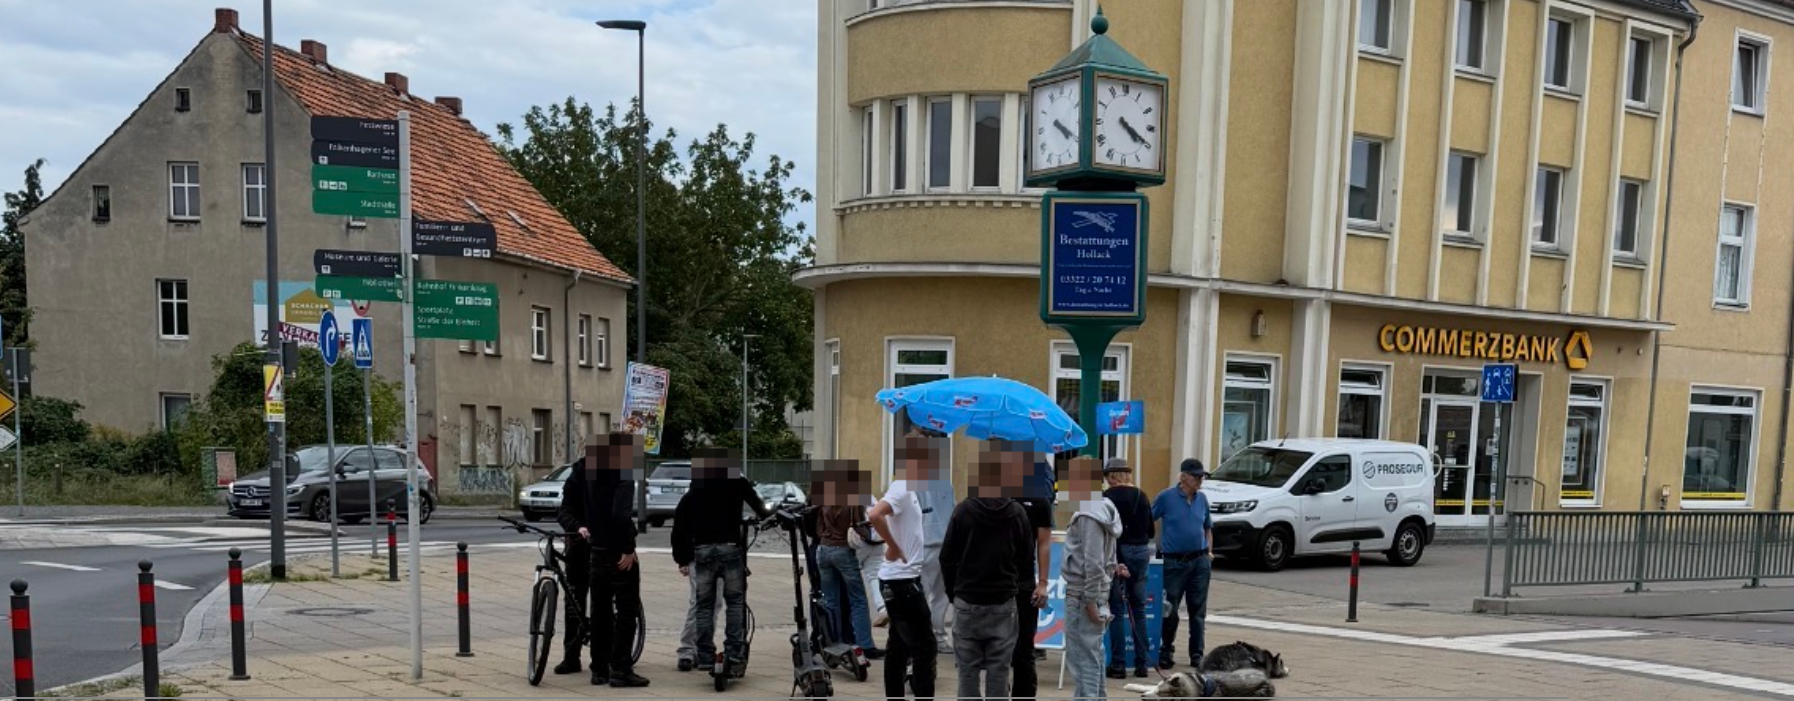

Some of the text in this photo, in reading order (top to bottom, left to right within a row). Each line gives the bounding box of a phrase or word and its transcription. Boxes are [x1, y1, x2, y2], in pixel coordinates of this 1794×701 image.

[329, 143, 395, 155] Falkenhagener See
[366, 170, 396, 179] Rathaus
[360, 200, 396, 209] Stadthalle
[1060, 233, 1129, 249] Bestattungen
[356, 254, 371, 262] und
[373, 255, 398, 263] Galerie
[1076, 249, 1111, 259] Hollack
[1060, 275, 1086, 284] 03322
[1092, 276, 1103, 284] 20
[1117, 276, 1127, 285] 12
[417, 282, 447, 290] Bahnhof
[1074, 285, 1087, 295] Tag
[417, 306, 454, 315] Sportplatz
[417, 316, 440, 325] Straße
[442, 317, 454, 325] der
[1379, 323, 1560, 363] COMMERZBANK
[1377, 463, 1424, 475] PROSEGUR
